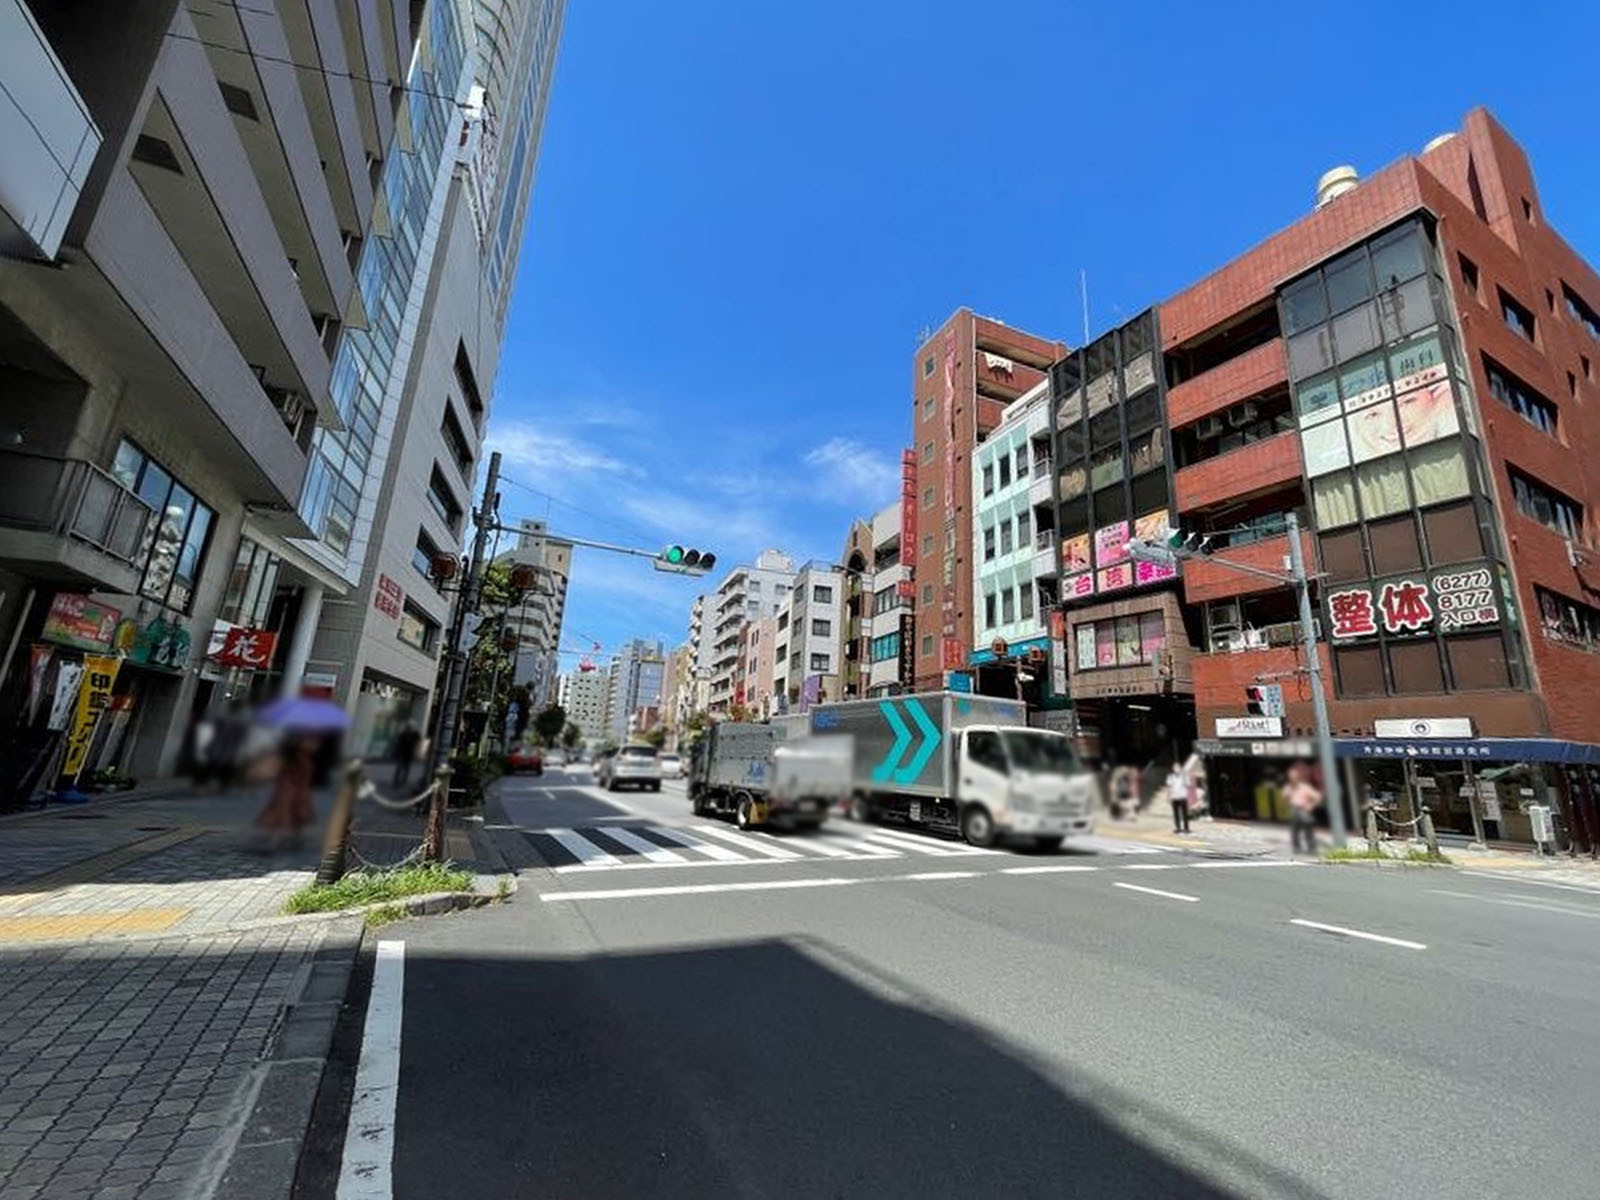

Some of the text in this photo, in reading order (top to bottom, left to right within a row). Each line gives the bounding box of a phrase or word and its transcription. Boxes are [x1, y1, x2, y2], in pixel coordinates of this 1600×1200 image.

[1433, 570, 1492, 594] (6277)
[1330, 583, 1432, 635] 整体
[1440, 589, 1491, 609] 8177
[227, 634, 267, 663] 花
